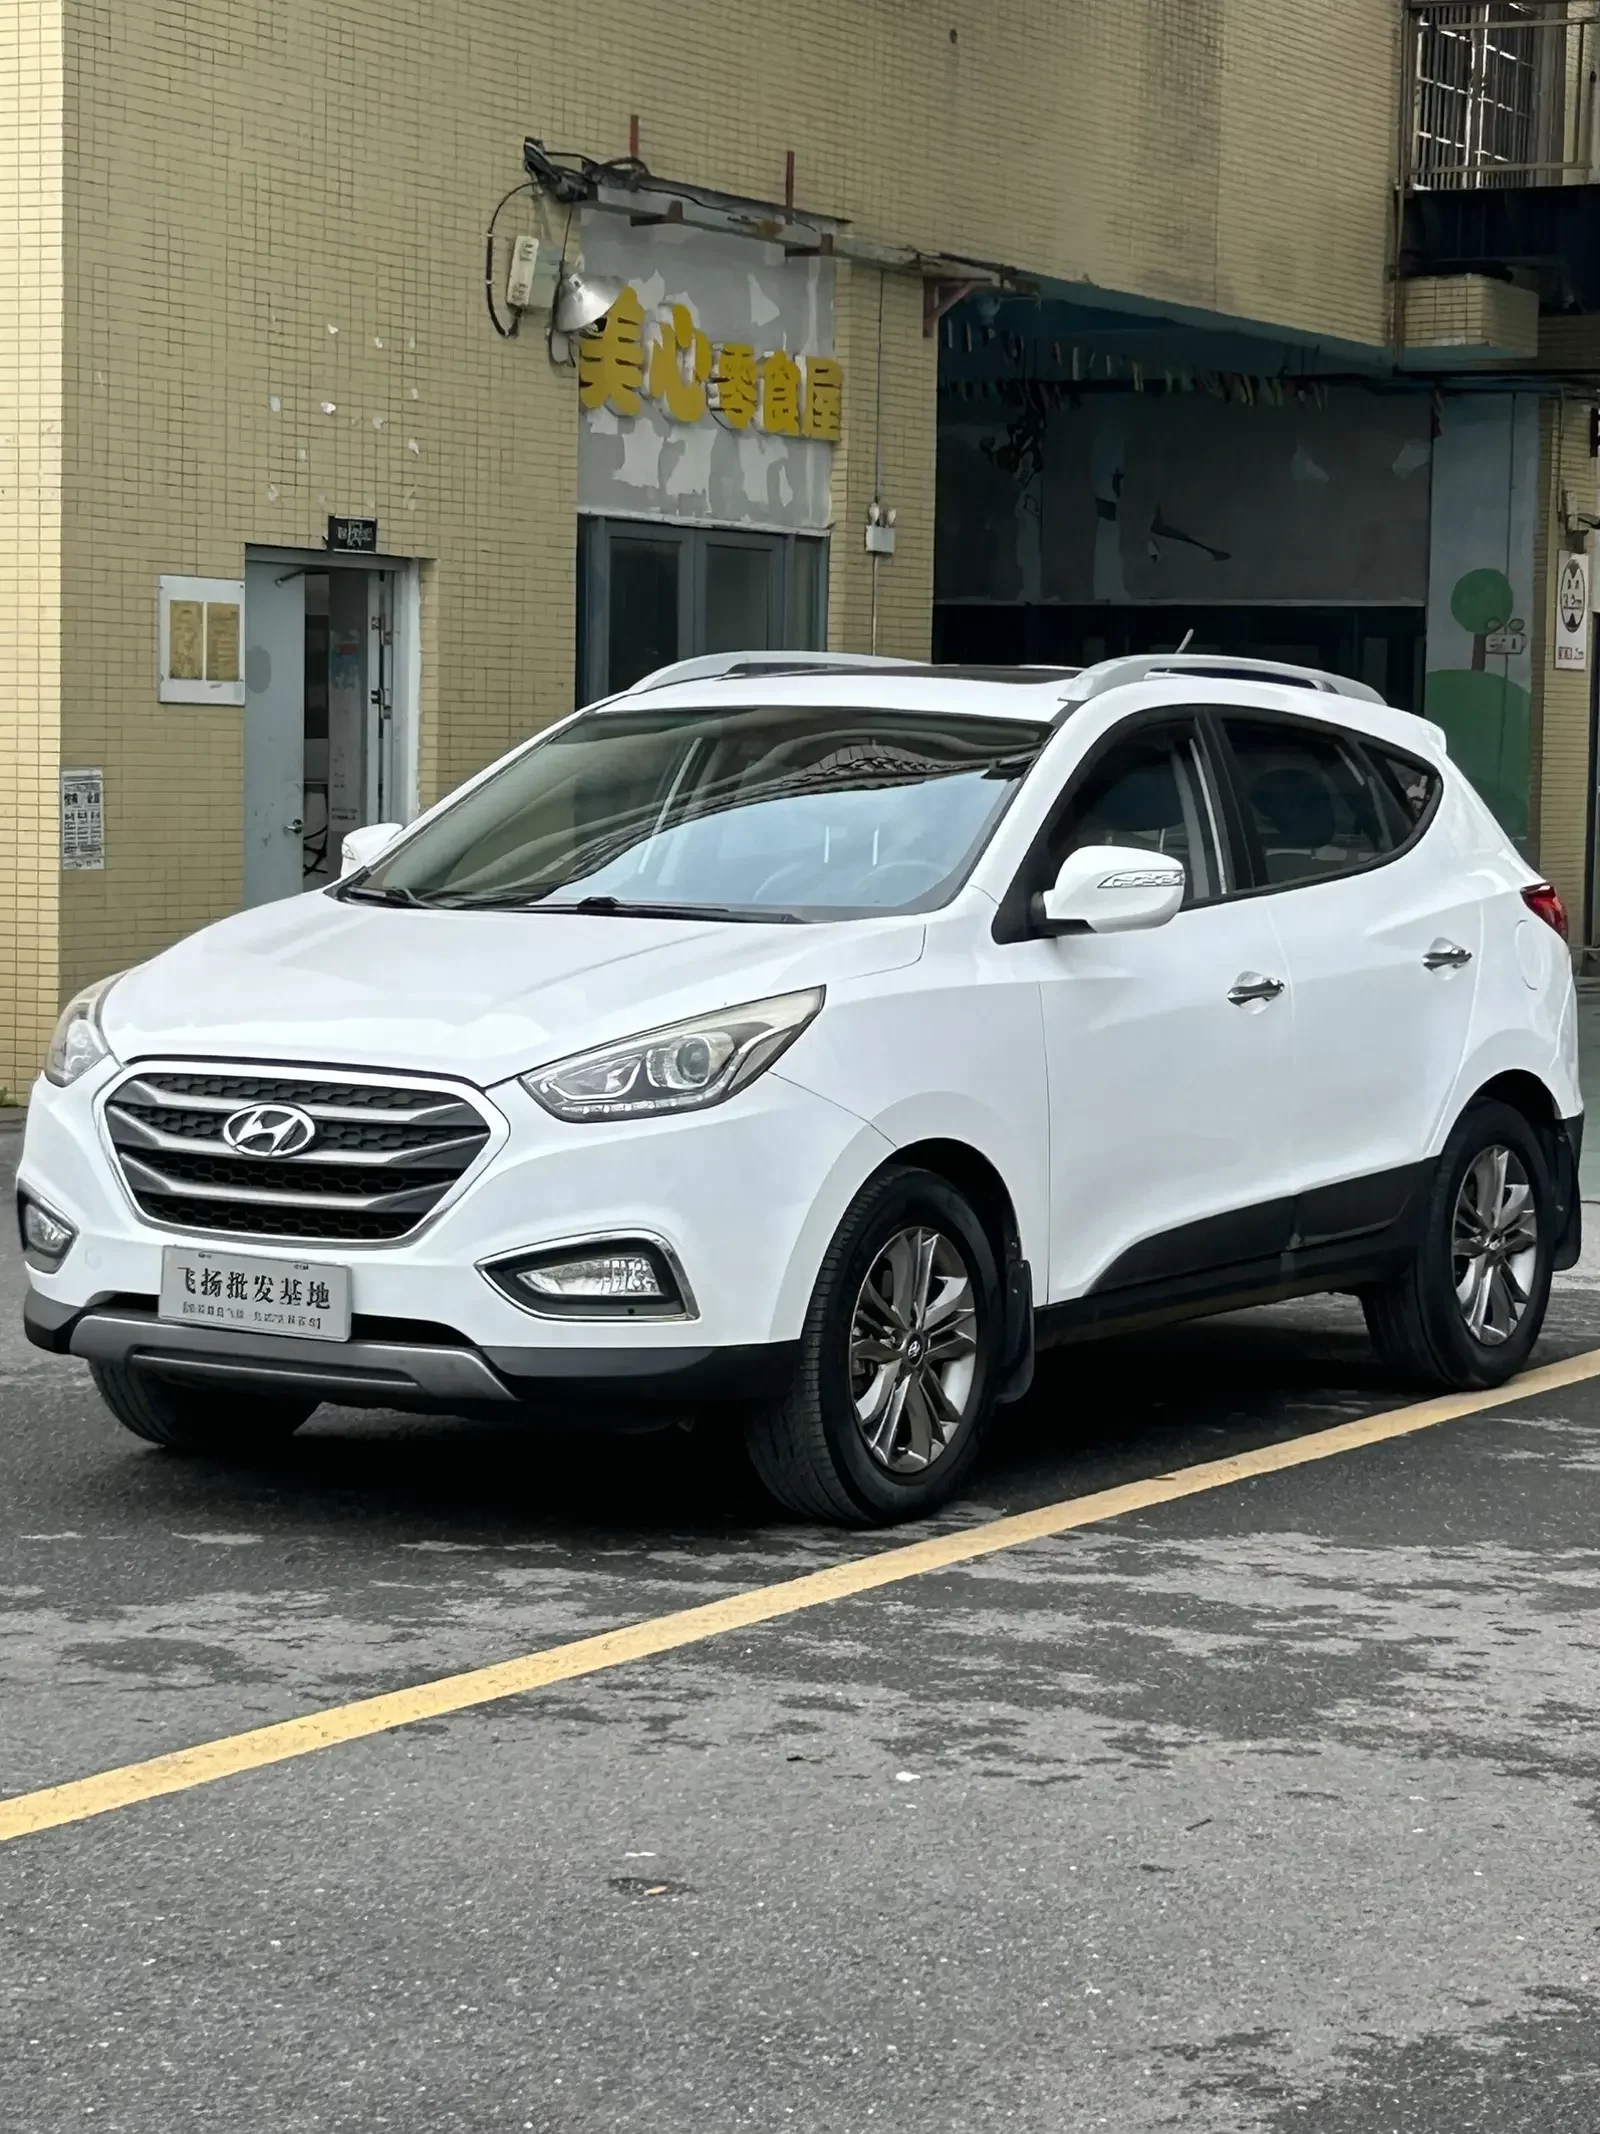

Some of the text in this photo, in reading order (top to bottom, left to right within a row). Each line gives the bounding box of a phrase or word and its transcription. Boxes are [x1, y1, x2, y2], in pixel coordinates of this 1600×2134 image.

[579, 286, 844, 441] 美心零食屋
[177, 1266, 331, 1310] 飞扬批发基地
